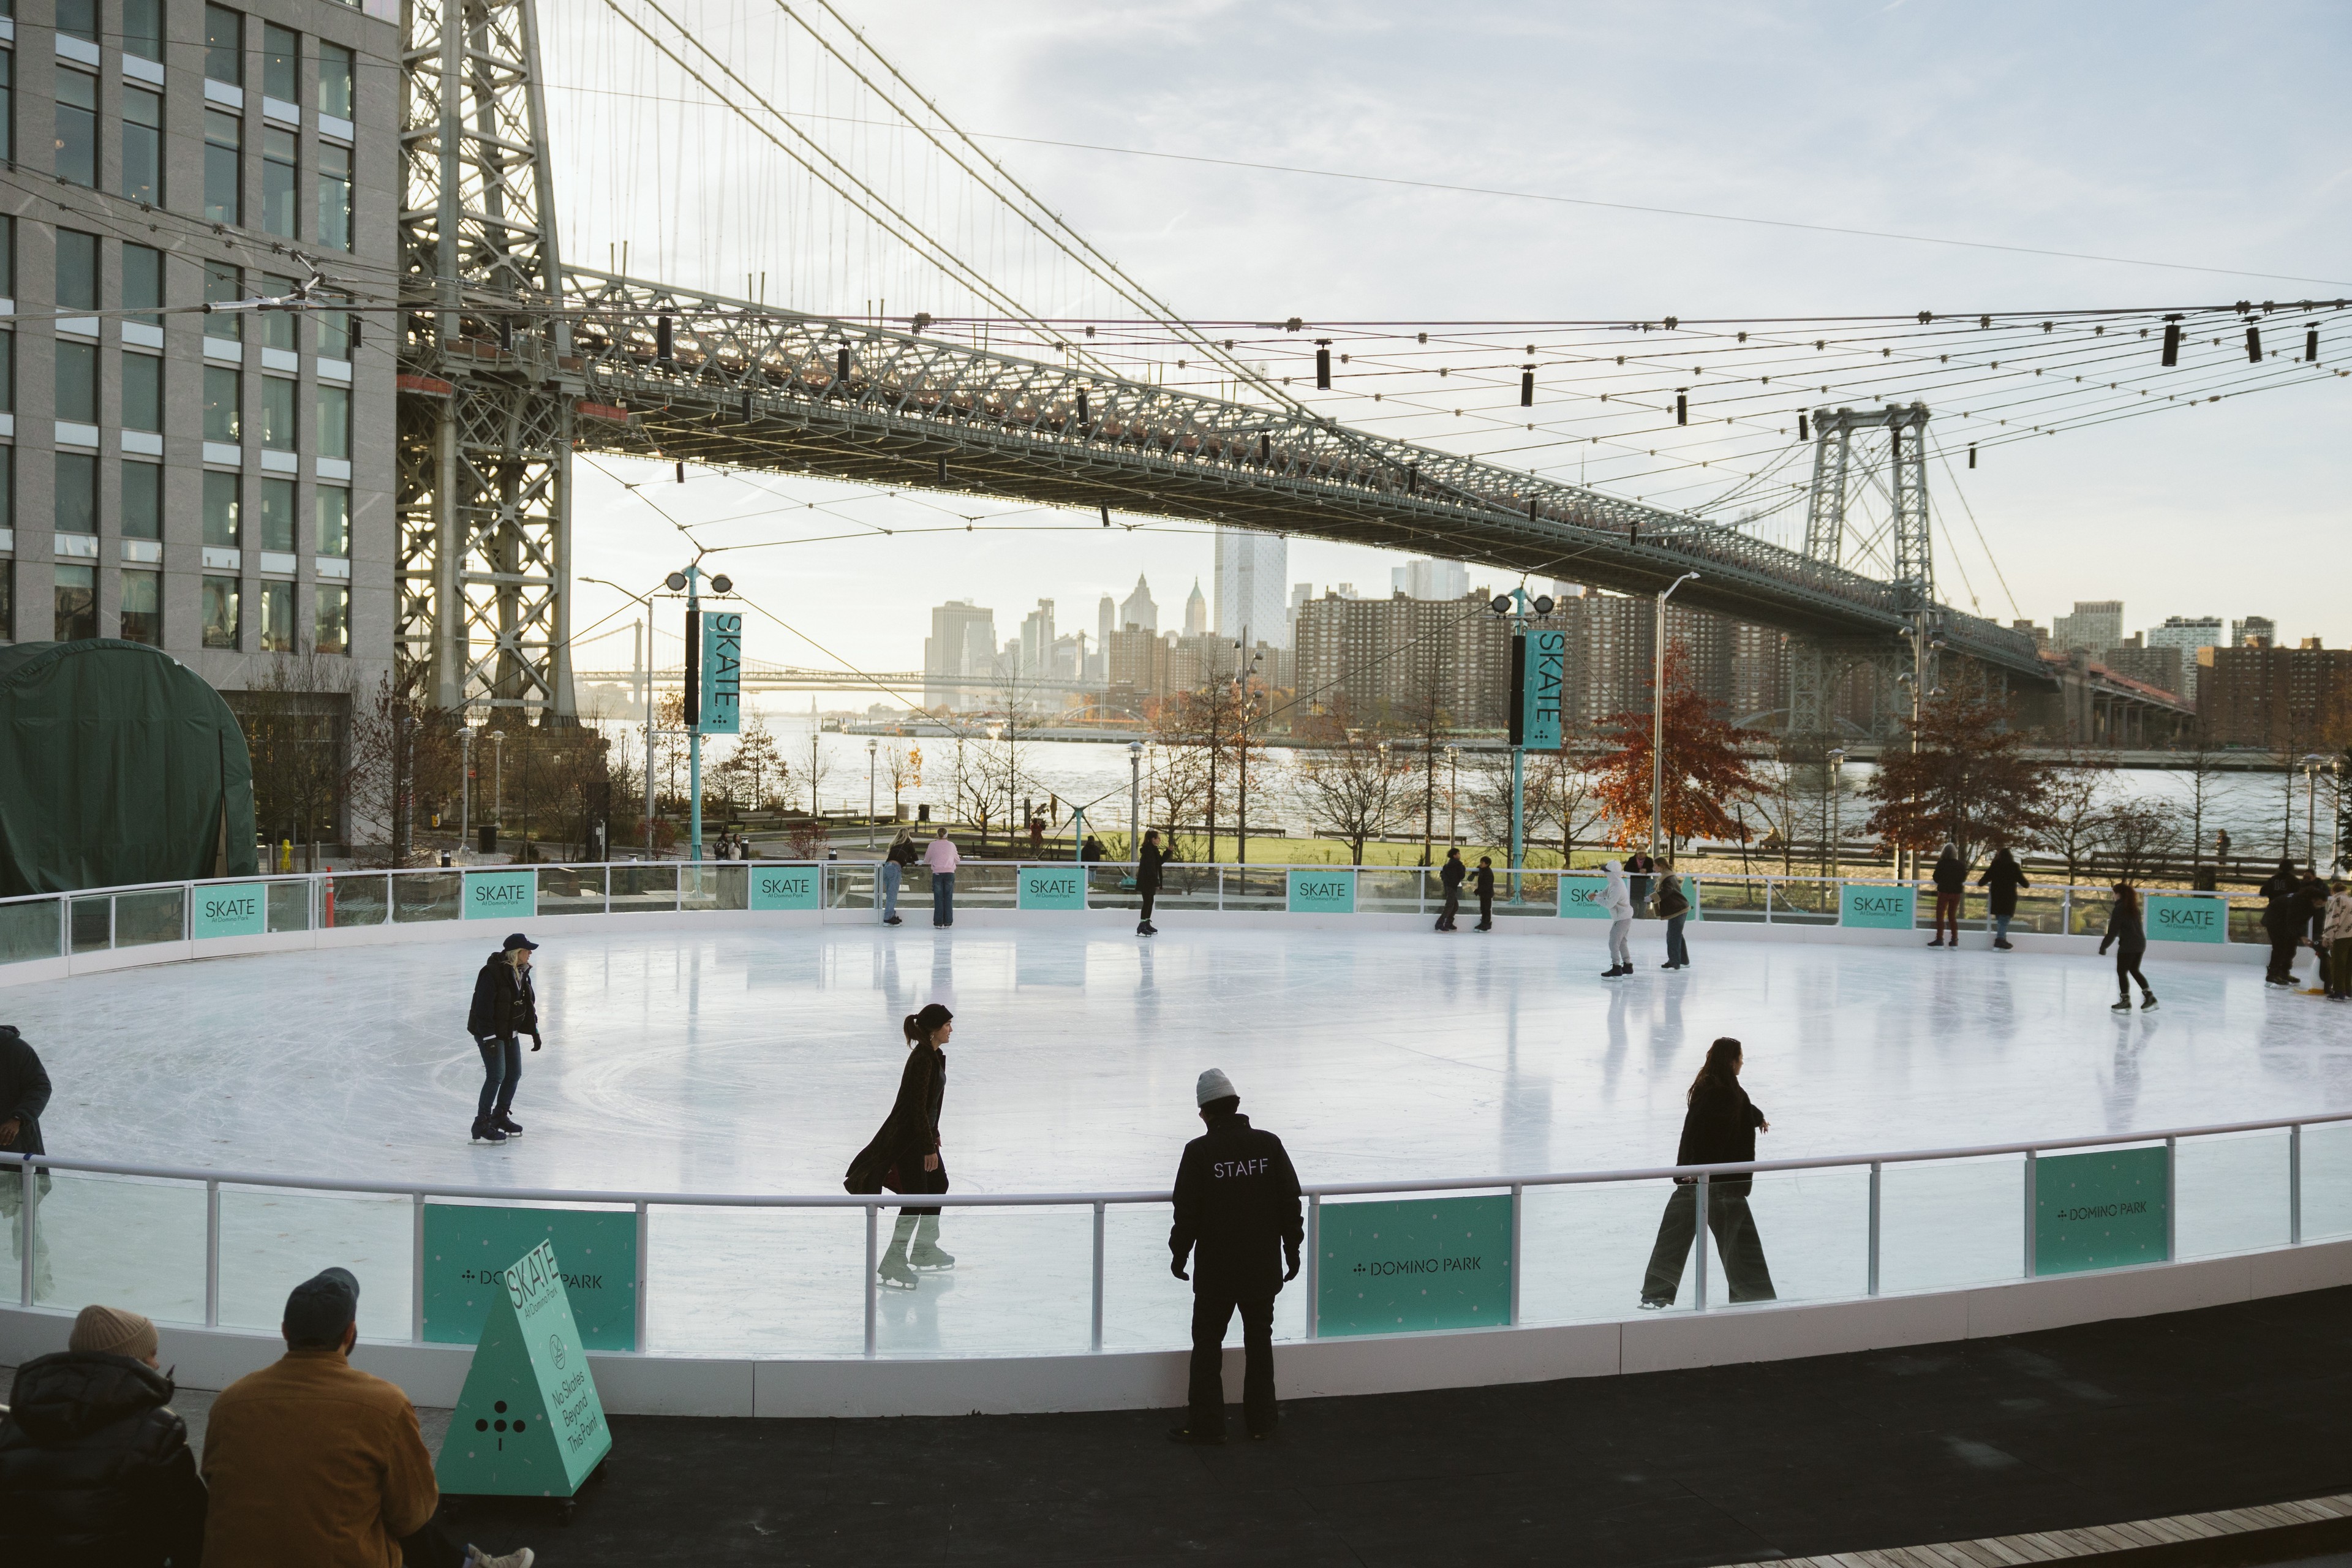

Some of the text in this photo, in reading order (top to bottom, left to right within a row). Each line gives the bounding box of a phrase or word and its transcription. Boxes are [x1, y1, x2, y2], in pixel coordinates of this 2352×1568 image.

[715, 614, 742, 707] SKATE
[1537, 633, 1564, 723] SKATE
[475, 885, 524, 901] SKATE
[762, 880, 809, 893] SKATE
[1030, 880, 1076, 893] SKATE
[1300, 883, 1345, 897] SKATE
[206, 899, 255, 918] SKATE
[1854, 897, 1904, 912] SKATE
[2160, 909, 2215, 925] SKATE
[1215, 1158, 1268, 1178] STAFF
[2070, 1201, 2147, 1221] DOMINO PARK
[507, 1241, 559, 1310] SKATE
[1371, 1256, 1481, 1276] DOMINO PARK
[524, 1286, 558, 1321] At Domino Park
[552, 1371, 584, 1409] No Skates
[562, 1389, 588, 1427] Beyond
[567, 1411, 598, 1454] This Point
